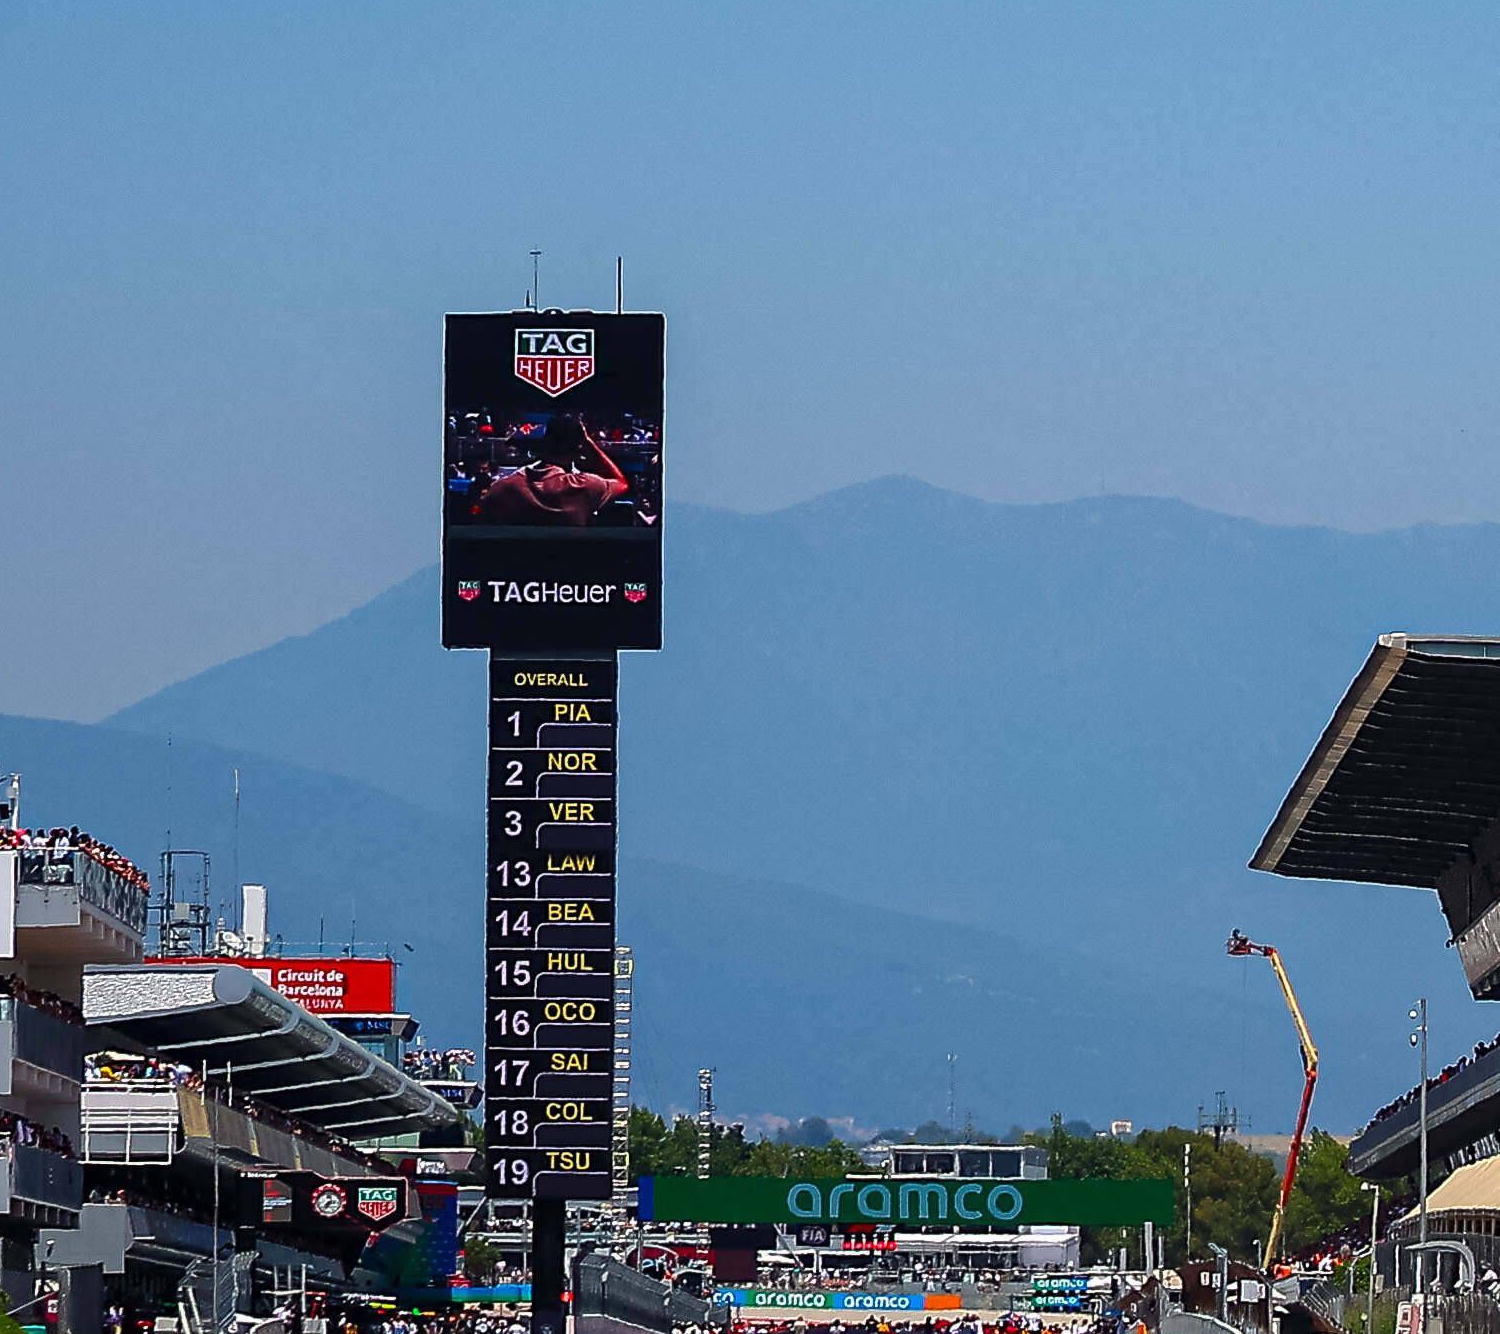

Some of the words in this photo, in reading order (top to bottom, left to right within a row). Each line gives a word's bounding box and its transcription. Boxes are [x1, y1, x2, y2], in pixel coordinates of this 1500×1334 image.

[521, 333, 588, 354] TAG
[519, 359, 590, 391] HEUER
[514, 672, 588, 687] OVERALL
[507, 711, 520, 737] 1
[554, 704, 592, 722] PIA
[505, 760, 523, 786] 2
[548, 753, 597, 771] NOR
[504, 810, 522, 836] 3
[549, 803, 594, 821] VER
[496, 860, 531, 887] 13
[547, 854, 596, 872] LAW
[495, 910, 531, 936] 14
[548, 903, 595, 921] BEA
[278, 969, 325, 983] Circuit
[327, 969, 344, 983] de
[494, 960, 531, 986] 15
[548, 953, 594, 971] HUL
[278, 983, 344, 997] Barcelona
[494, 1009, 530, 1036] 16
[544, 1002, 596, 1021] OCO
[494, 1059, 530, 1086] 17
[550, 1053, 588, 1071] SAI
[494, 1110, 529, 1136] 18
[546, 1102, 593, 1121] COL
[493, 1158, 529, 1185] 19
[545, 1152, 590, 1170] TSU
[362, 1189, 393, 1201] TAG
[787, 1182, 1023, 1220] aramco
[755, 1293, 826, 1308] aramco
[843, 1296, 910, 1309] aramco
